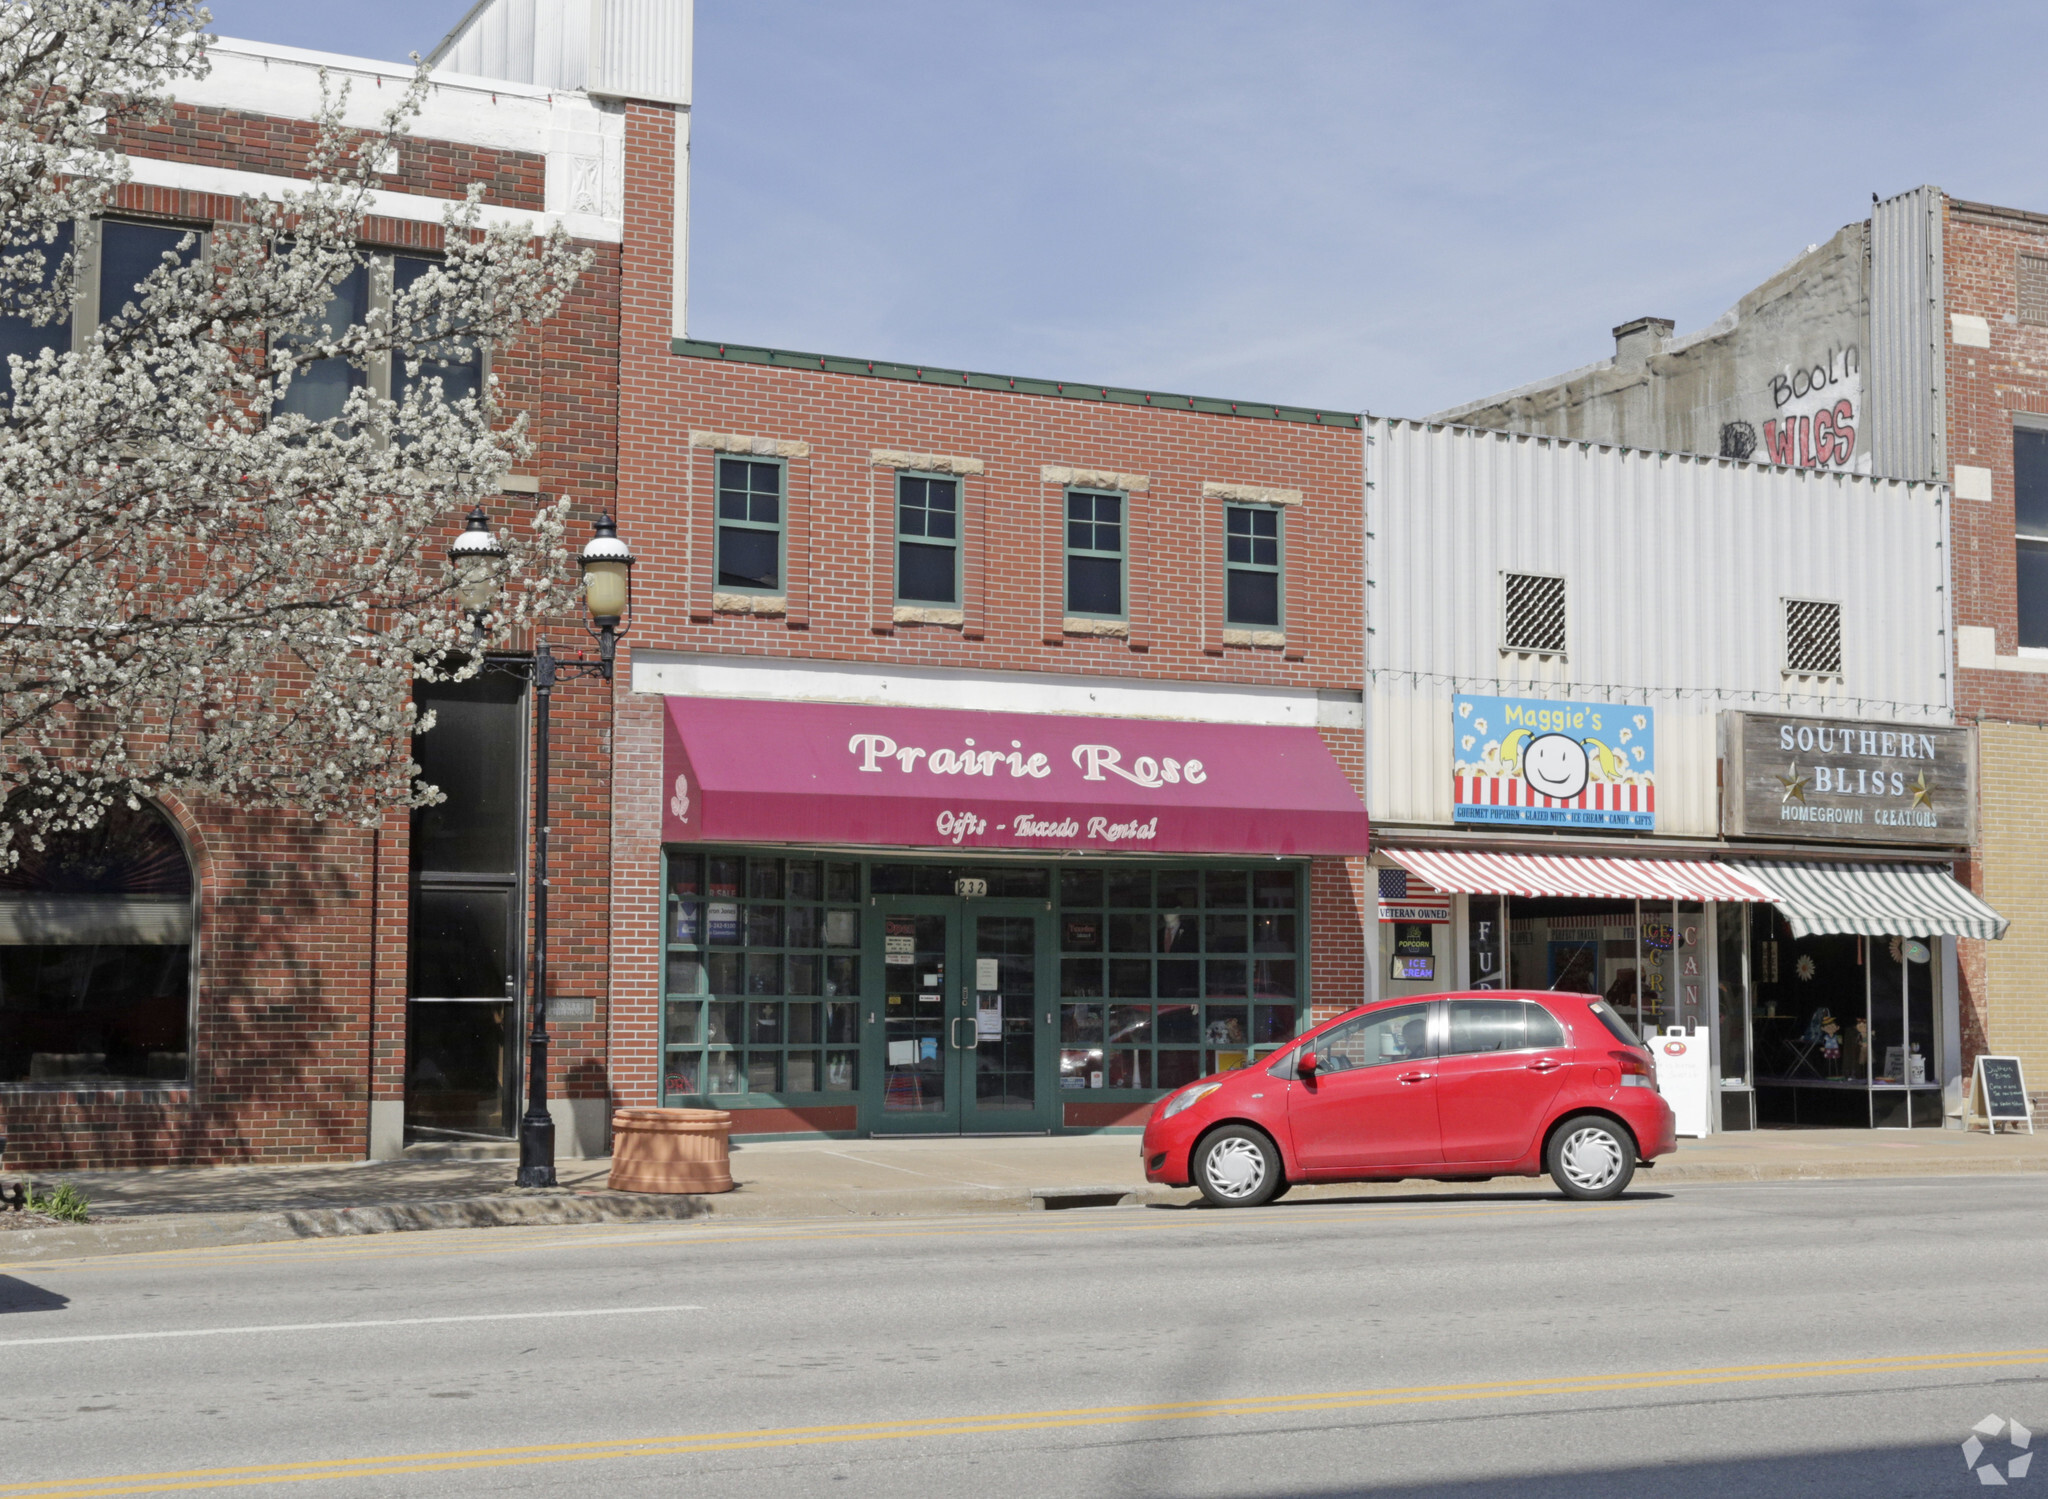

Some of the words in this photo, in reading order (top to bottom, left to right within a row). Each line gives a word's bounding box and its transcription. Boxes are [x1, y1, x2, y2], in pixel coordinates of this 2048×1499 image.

[1505, 704, 1602, 732] Maggie's
[1780, 725, 1936, 760] SOUTHERN
[848, 733, 1051, 779] Prairie
[1072, 743, 1208, 789] Rose
[1814, 766, 1905, 797] BLISS
[1456, 807, 1490, 819] GOURMET
[1490, 808, 1521, 820] POPCORN
[1525, 810, 1549, 822] GLAZED
[1549, 811, 1567, 822] NUTS
[1571, 812, 1582, 823] ICE
[1582, 813, 1604, 823] CREAM
[1609, 814, 1630, 825] CANDY
[1634, 815, 1653, 826] GIFTS
[1781, 805, 1864, 824] HOMEGROWN
[1874, 810, 1938, 828] CREATIONS
[936, 810, 987, 845] Gifts
[1013, 814, 1079, 839] Tuxedo
[1087, 816, 1158, 841] Rental
[959, 881, 985, 894] 232
[1379, 908, 1416, 919] VETERAN
[1418, 908, 1447, 919] OWNED
[1643, 923, 1671, 938] ICE
[1402, 968, 1433, 978] CREAM
[1409, 959, 1426, 968] ICE
